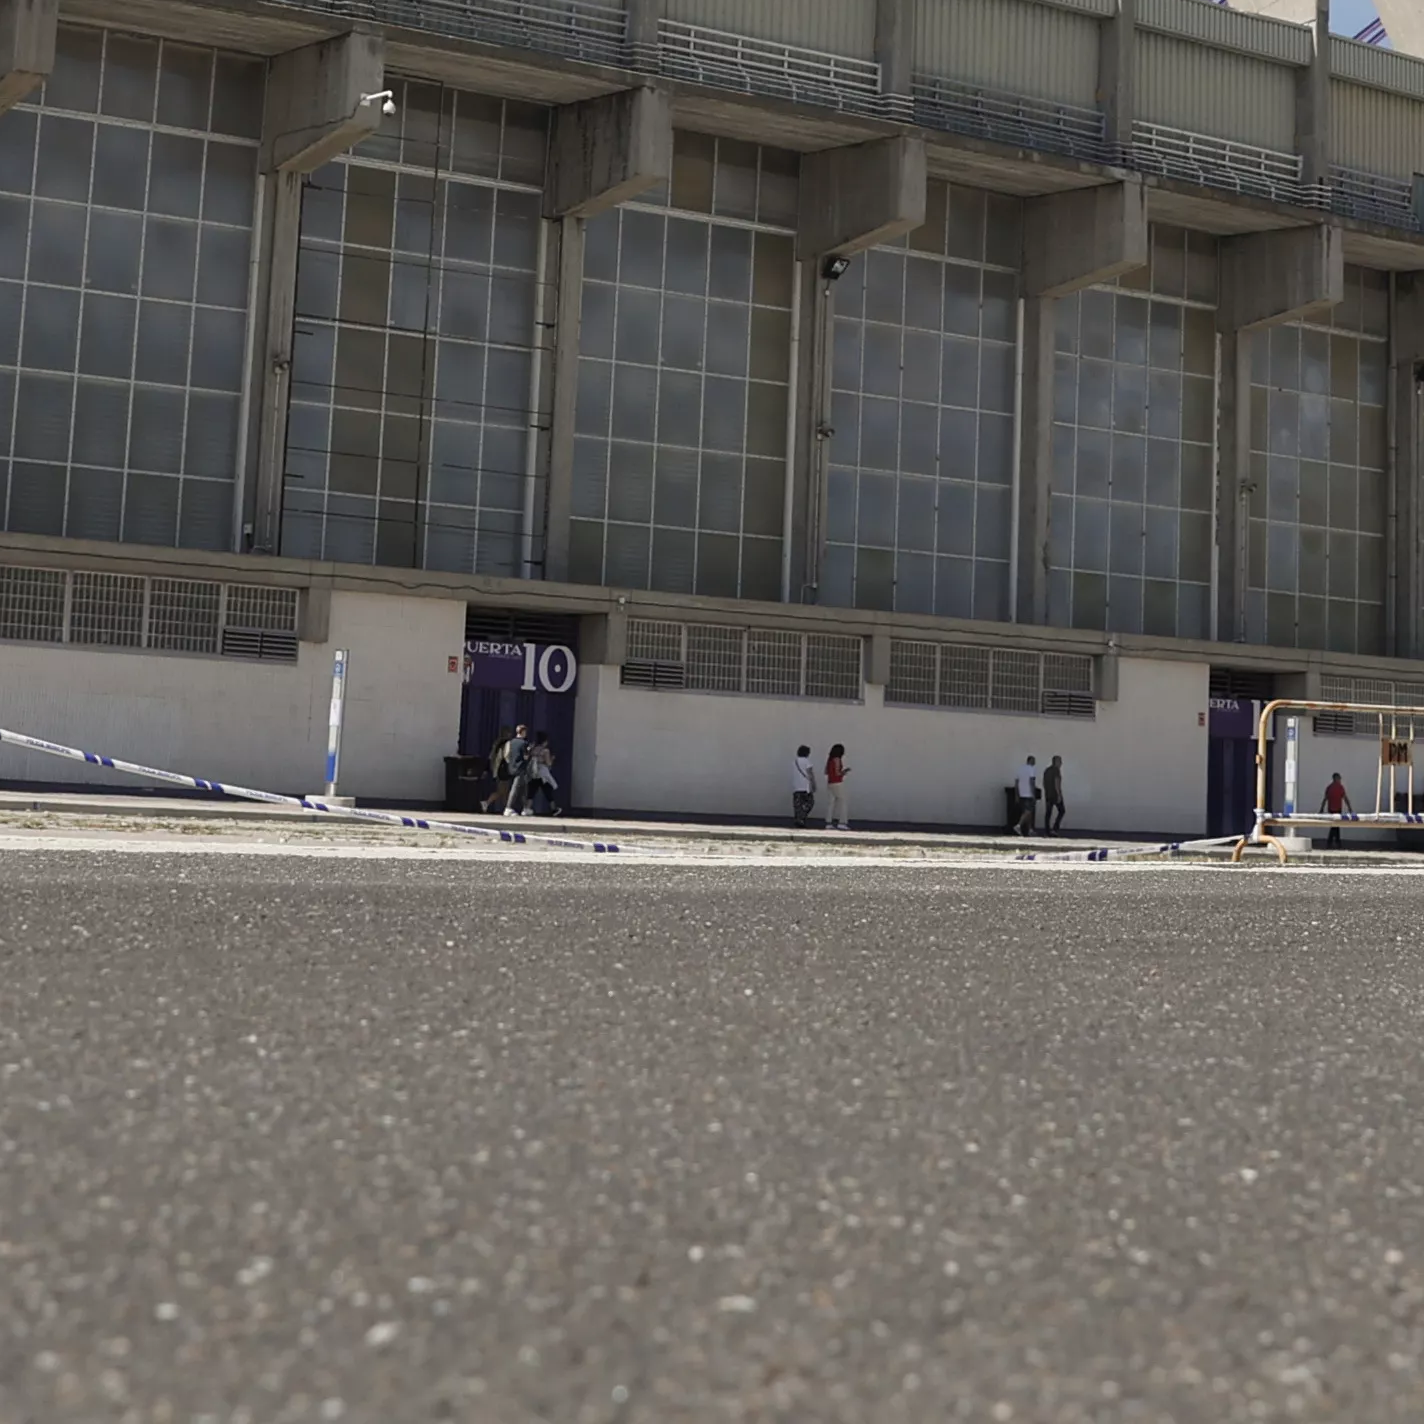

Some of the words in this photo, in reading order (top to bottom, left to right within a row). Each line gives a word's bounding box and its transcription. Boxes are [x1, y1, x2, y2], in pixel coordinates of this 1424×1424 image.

[466, 641, 523, 656] UERTA
[521, 642, 577, 692] 10
[1209, 698, 1239, 711] ERTA
[1388, 742, 1409, 763] PM
